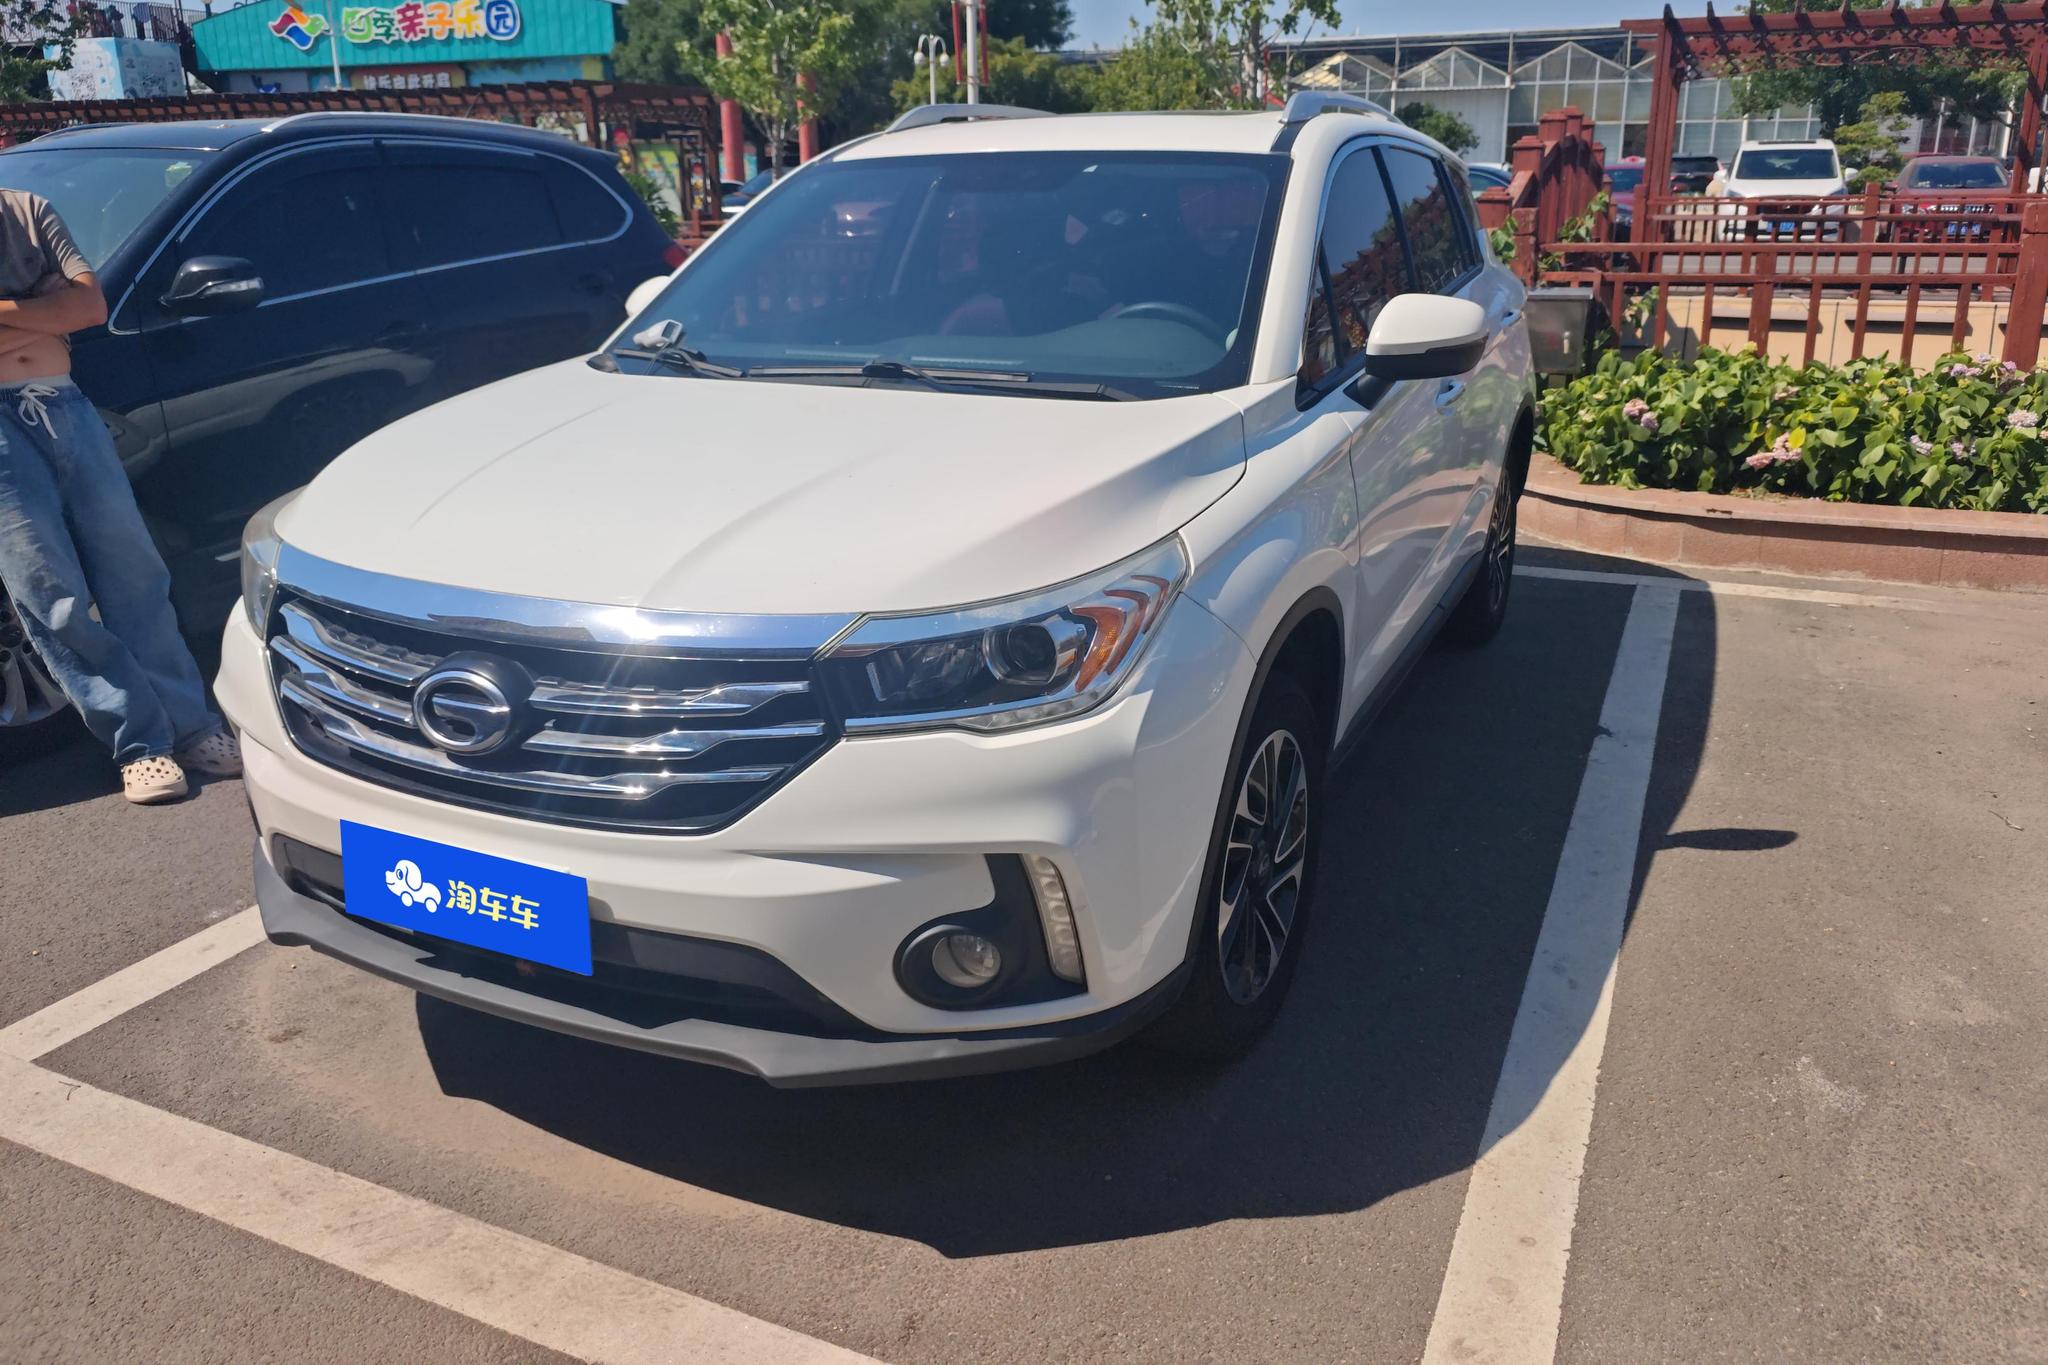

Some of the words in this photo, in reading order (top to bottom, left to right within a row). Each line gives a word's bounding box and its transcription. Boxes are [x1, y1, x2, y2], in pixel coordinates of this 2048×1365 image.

[343, 0, 519, 43] 四季亲子乐园
